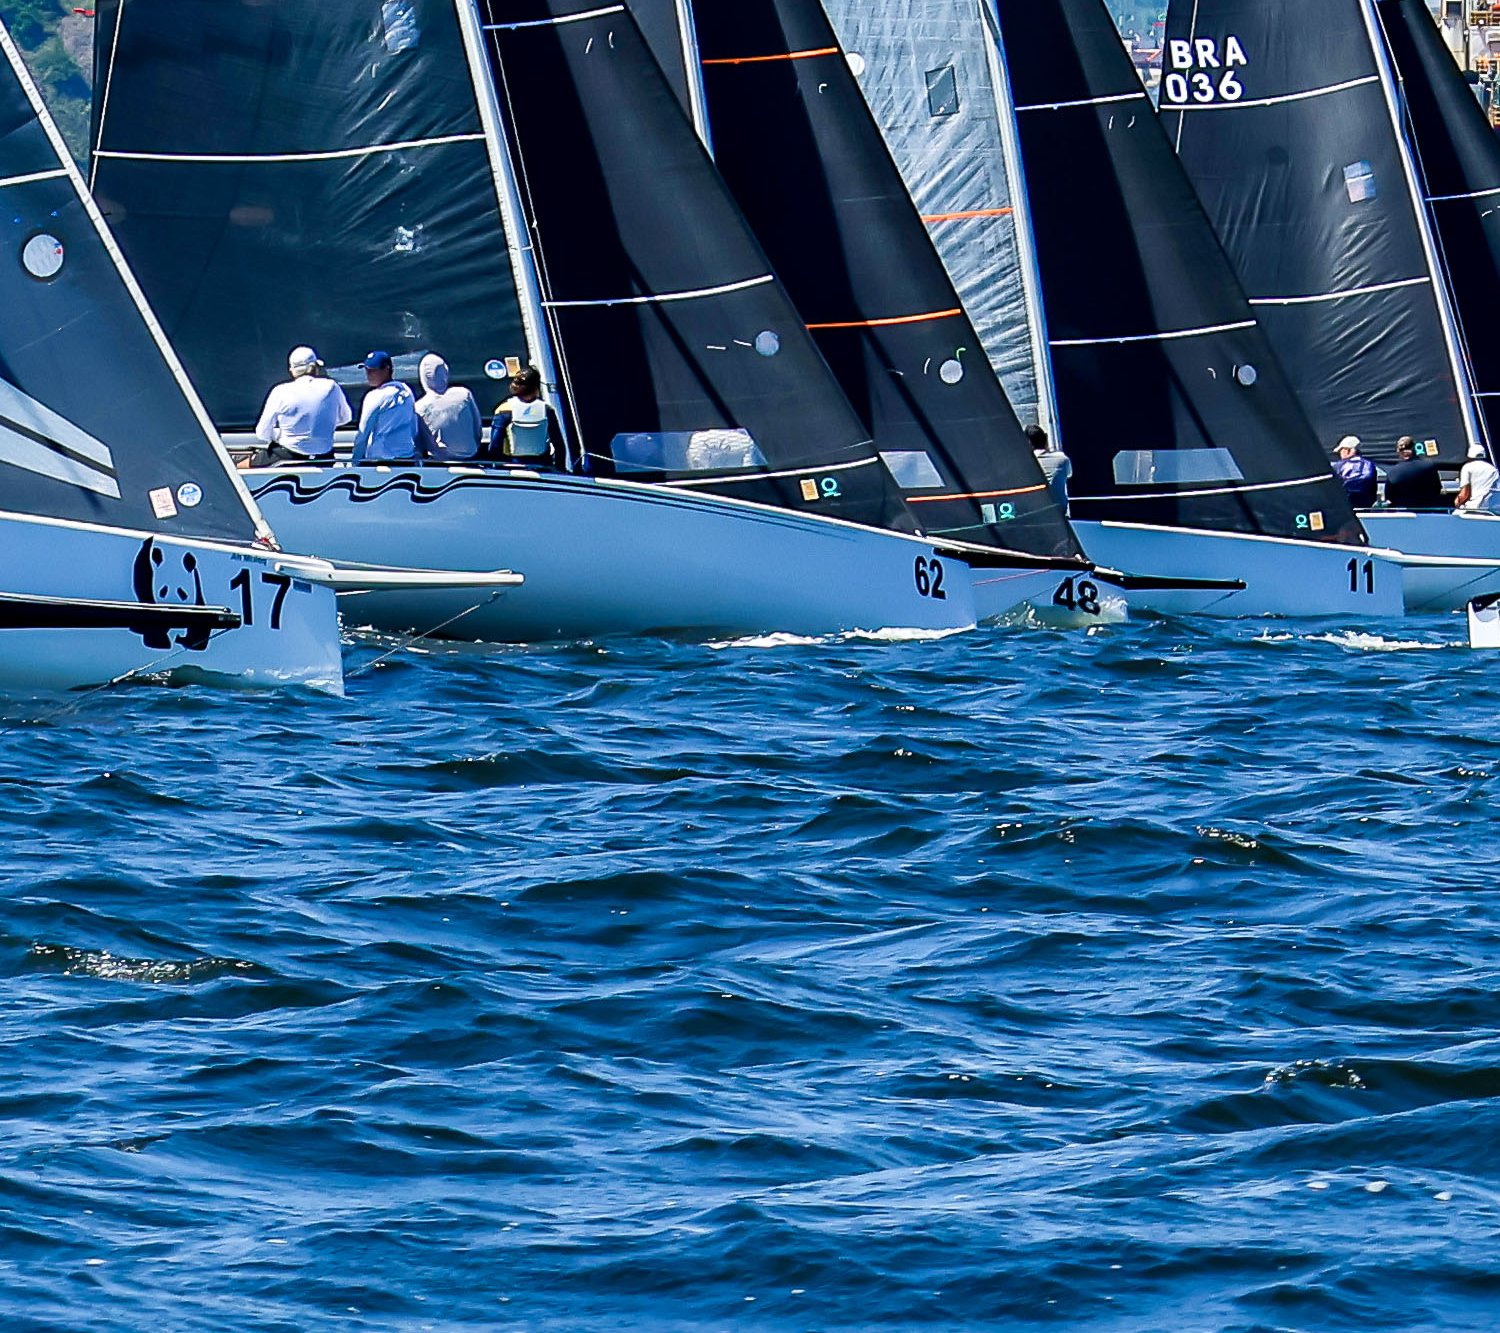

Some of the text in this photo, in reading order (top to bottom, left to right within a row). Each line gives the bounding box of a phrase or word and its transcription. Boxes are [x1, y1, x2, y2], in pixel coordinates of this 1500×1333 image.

[1170, 36, 1247, 68] BRA
[1166, 71, 1242, 103] 036
[914, 556, 947, 600] 62
[1346, 557, 1374, 594] 11
[230, 568, 291, 630] 17
[1052, 576, 1101, 616] 48
